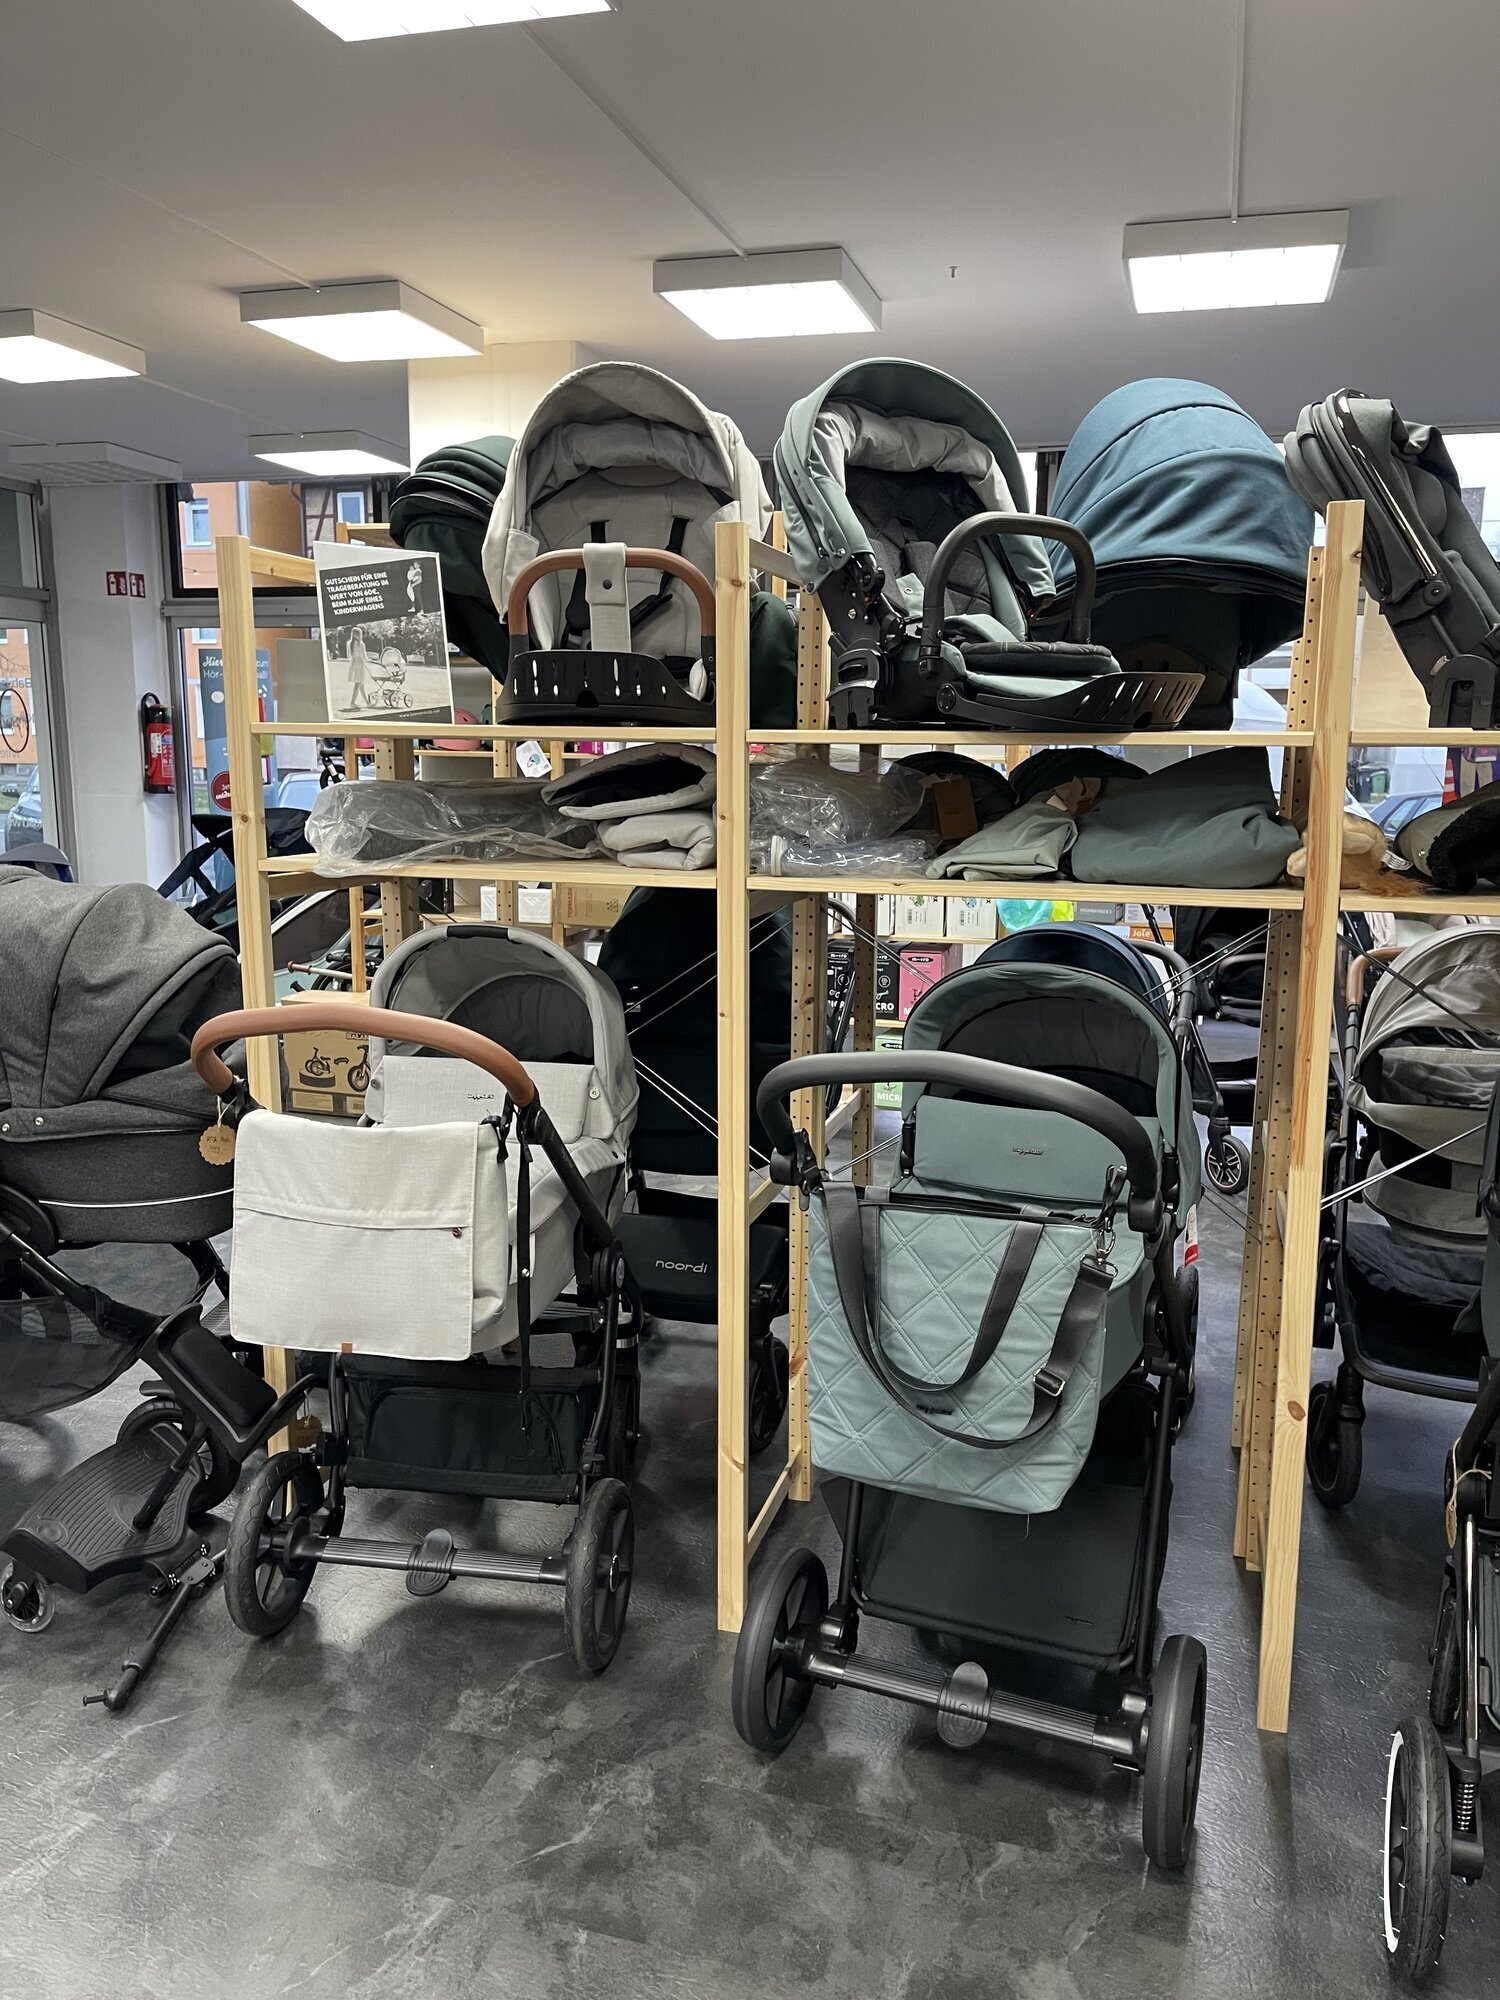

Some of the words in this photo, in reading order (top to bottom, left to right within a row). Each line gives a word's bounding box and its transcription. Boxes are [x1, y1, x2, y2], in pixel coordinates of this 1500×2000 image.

[324, 575, 361, 586] GUTSCHEIN
[360, 572, 374, 581] FÜR
[373, 571, 388, 579] EINE
[326, 581, 381, 593] TRAGEBERATUNG
[328, 592, 348, 601] WERT
[347, 590, 364, 598] VON
[331, 599, 348, 608] BEIM
[347, 597, 365, 606] KAUF
[365, 595, 384, 604] EINES
[333, 602, 385, 615] KINDERWAGENS
[1132, 928, 1151, 938] Joie
[875, 1002, 895, 1011] CRO
[876, 1092, 901, 1102] MICR
[655, 1260, 708, 1274] noordi
